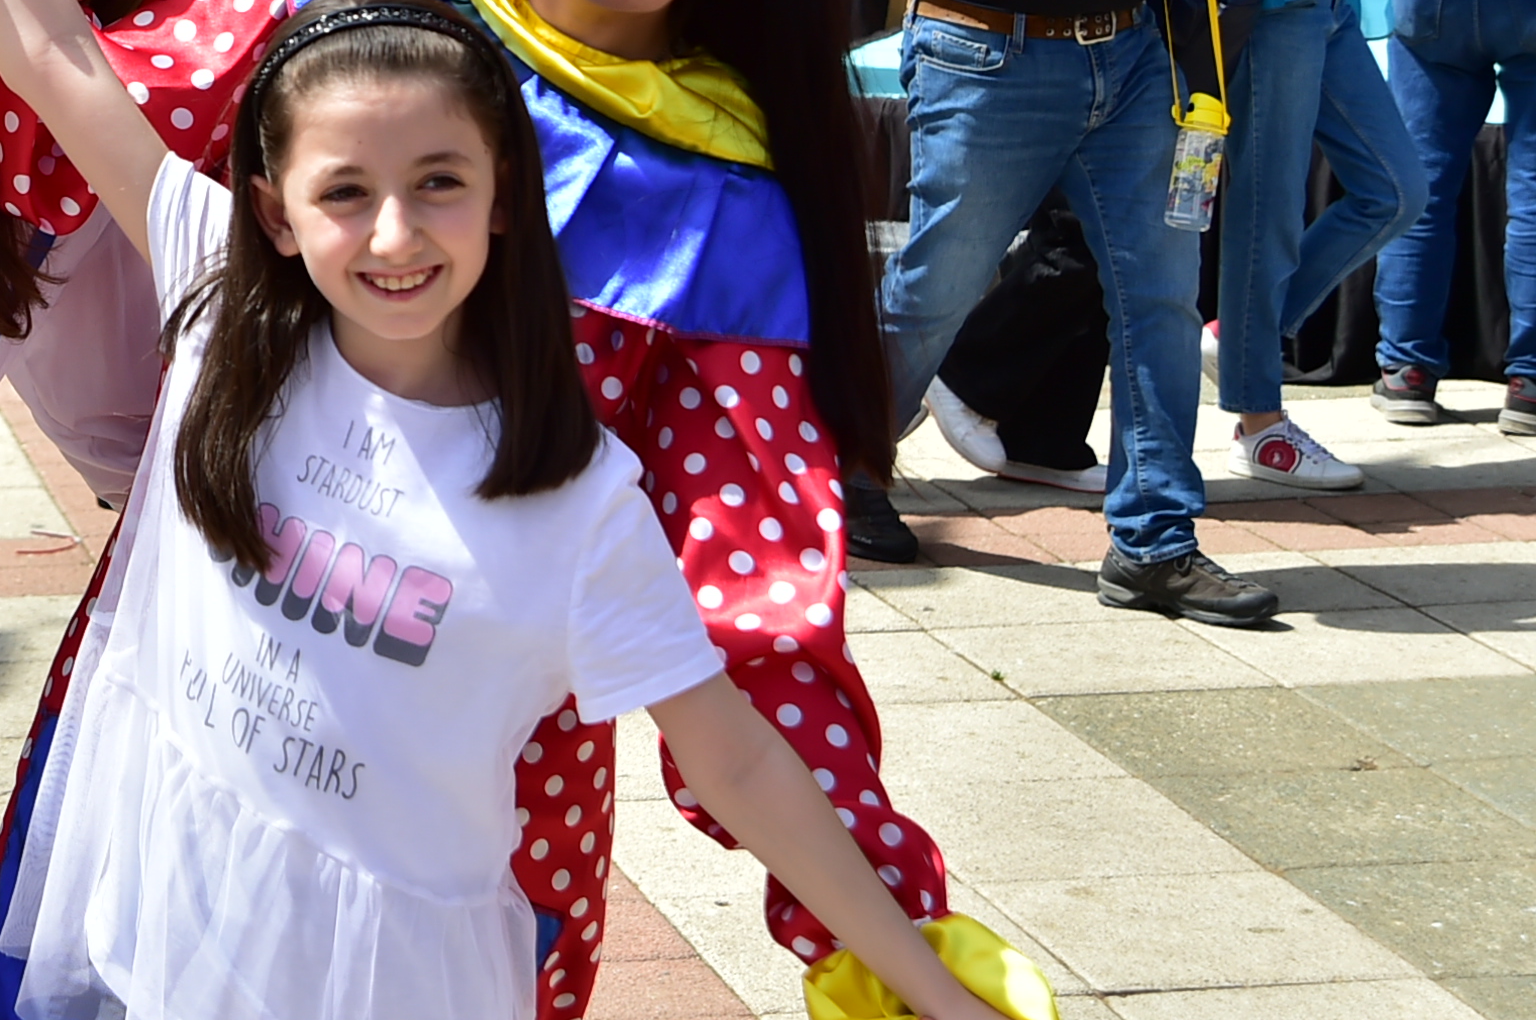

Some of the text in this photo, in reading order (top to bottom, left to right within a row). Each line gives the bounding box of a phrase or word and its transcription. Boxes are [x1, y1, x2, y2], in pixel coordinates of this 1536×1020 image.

[342, 420, 397, 465] I AM
[296, 454, 405, 518] STARDUST
[210, 502, 454, 668] HINE
[221, 651, 318, 733] UNIVERSE
[255, 631, 301, 684] IN A
[231, 706, 266, 755] OF
[272, 735, 366, 800] STARS
